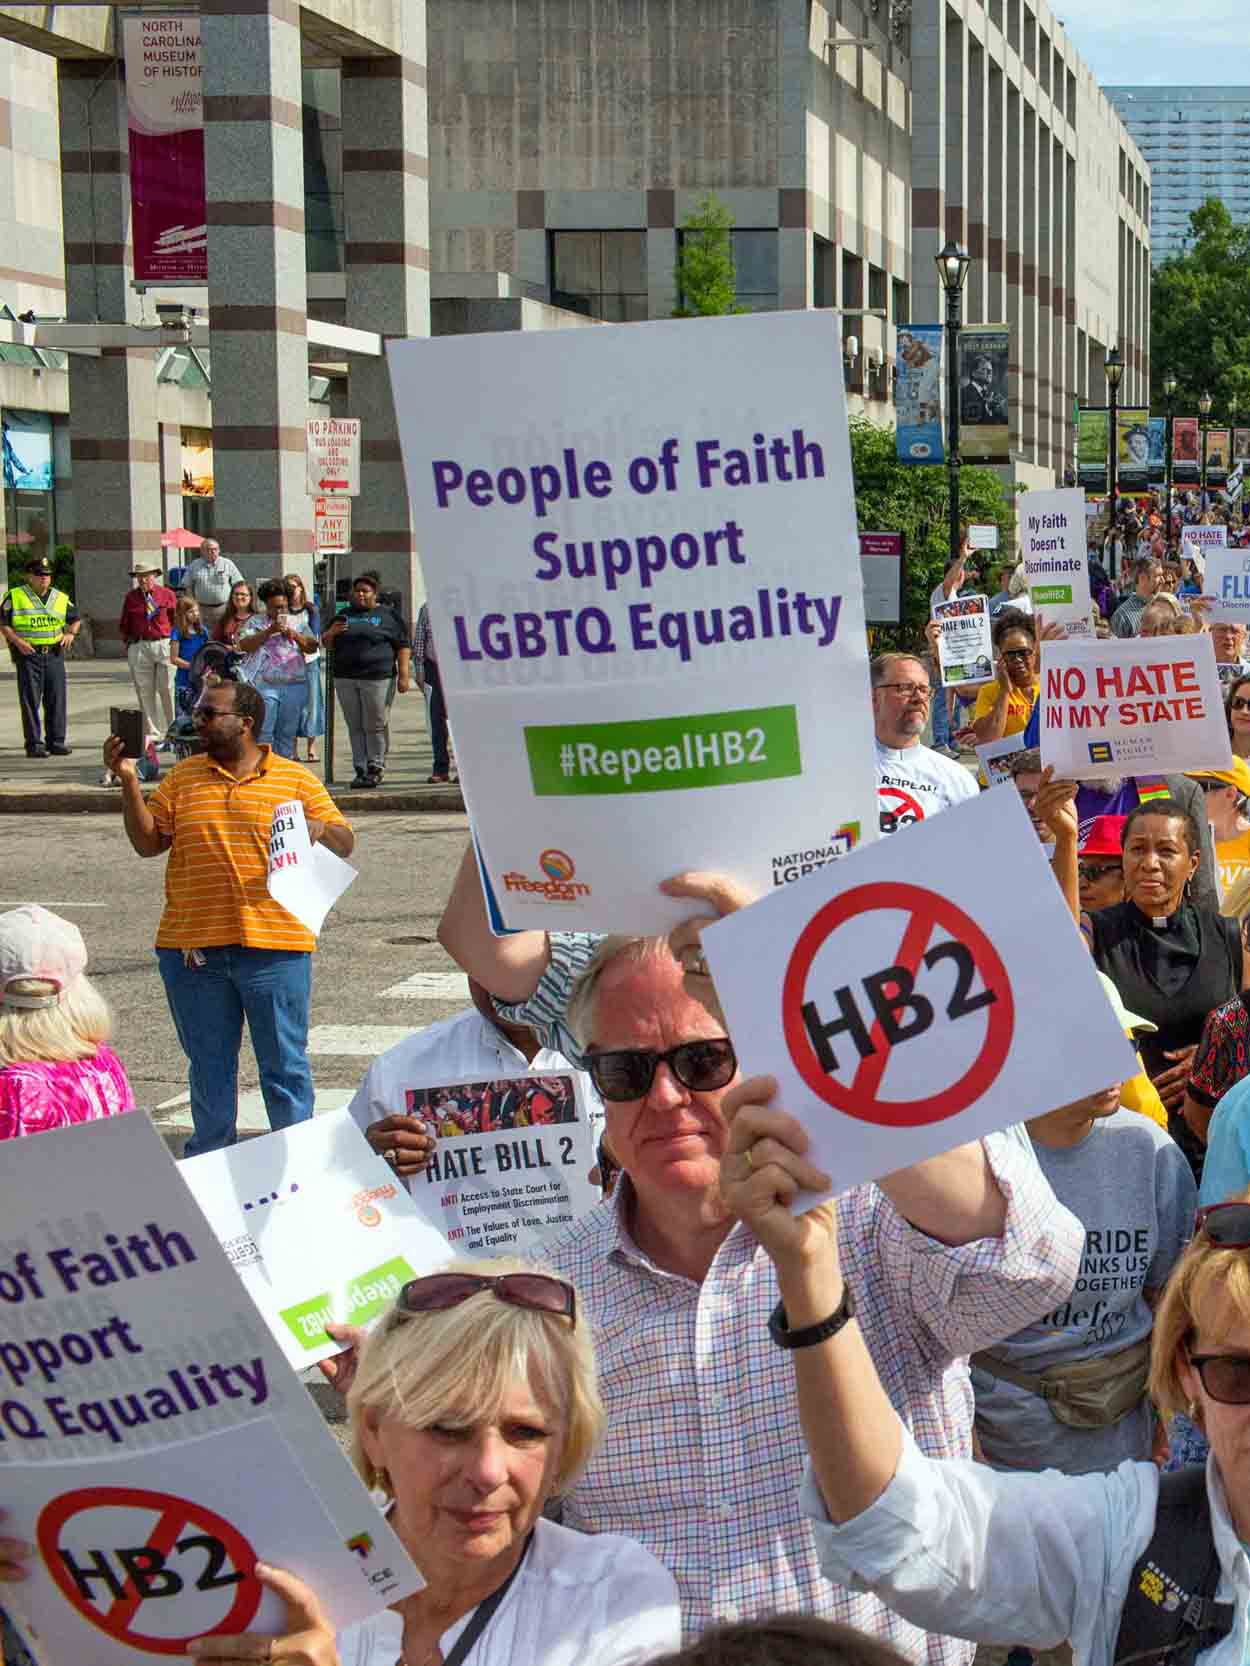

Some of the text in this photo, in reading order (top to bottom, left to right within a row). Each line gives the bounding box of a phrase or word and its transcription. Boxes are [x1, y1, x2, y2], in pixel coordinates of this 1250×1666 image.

[142, 21, 183, 32] NORTH
[143, 36, 202, 48] CAROLINA
[143, 50, 196, 62] MUSEUM
[144, 65, 204, 77] OF HISTO
[309, 421, 357, 435] NO PARKING
[432, 429, 825, 516] People of Faith
[323, 520, 343, 529] ANY
[1028, 513, 1067, 534] My Faith
[320, 531, 344, 541] TIME
[1031, 536, 1065, 552] Doesn't
[1184, 531, 1223, 539] NO HATE
[533, 521, 746, 590] Support
[1025, 557, 1081, 574] Discriminate
[454, 588, 843, 662] LGBTQ Equality
[1047, 661, 1200, 700] NO HATE
[1046, 697, 1206, 729] IN MY STATE
[559, 728, 767, 784] #RepealHB2
[771, 845, 843, 868] NATIONAL
[800, 941, 999, 1075] HB2
[425, 1136, 577, 1184] HATE BILL 2
[441, 1194, 458, 1207] ANTI
[461, 1191, 489, 1202] Access
[502, 1186, 523, 1197] State
[526, 1184, 547, 1194] Court
[550, 1182, 561, 1191] for
[463, 1194, 569, 1216] Employment Discrimination
[447, 1228, 465, 1241] ANTI
[466, 1226, 481, 1236] The
[483, 1221, 509, 1233] Values
[511, 1218, 520, 1227] of
[546, 1215, 573, 1225] Justice
[468, 1232, 518, 1249] and Equality
[0, 1223, 198, 1304] of Faith
[1126, 1255, 1148, 1272] US
[0, 1357, 271, 1443] Q Equality
[57, 1535, 246, 1601] HB2
